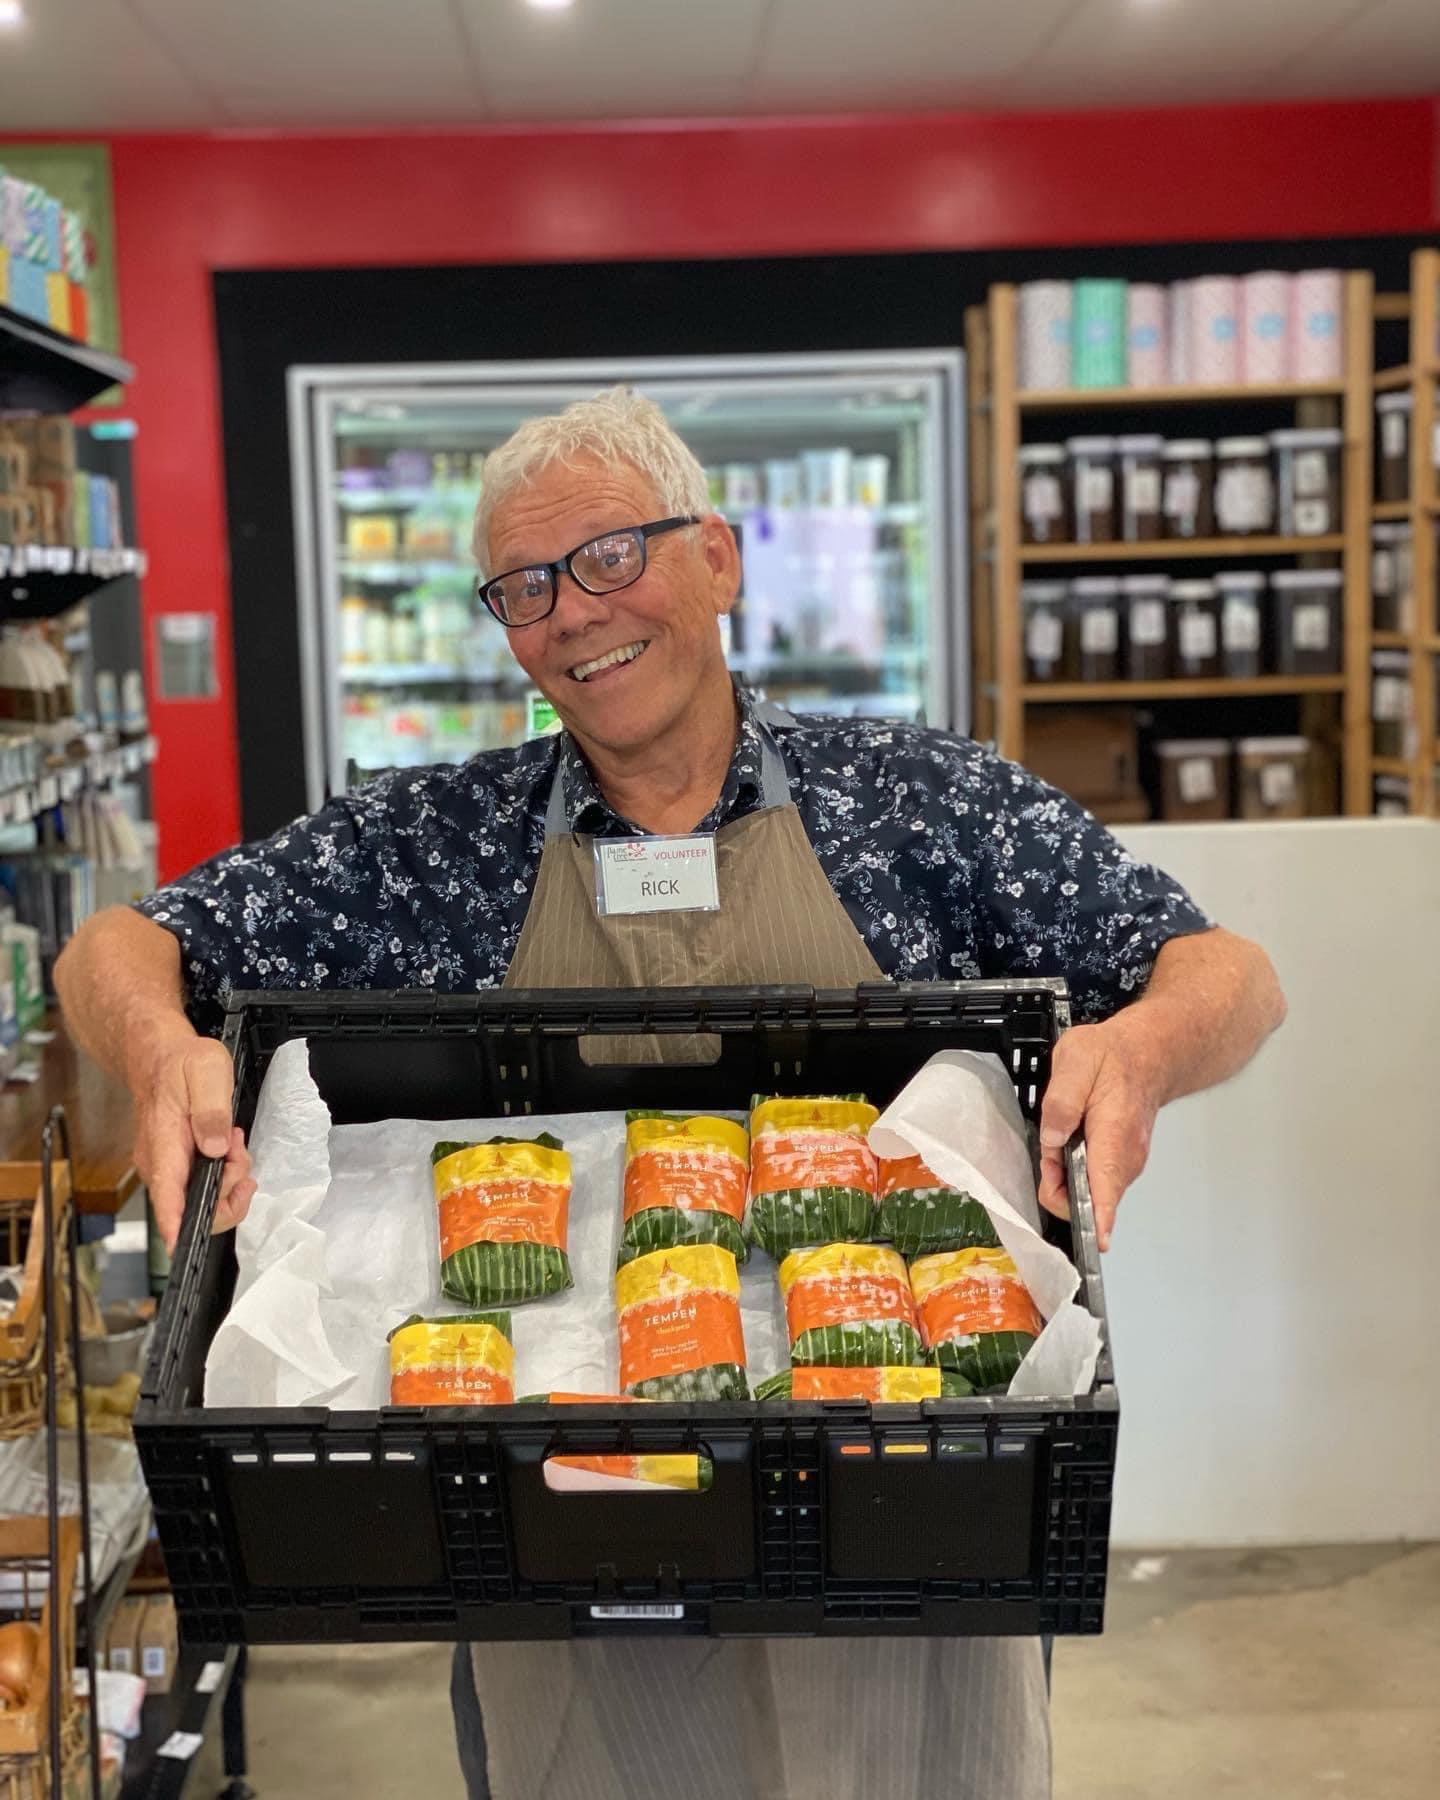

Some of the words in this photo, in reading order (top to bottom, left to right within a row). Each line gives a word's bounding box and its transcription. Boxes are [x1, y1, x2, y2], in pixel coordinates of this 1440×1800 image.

[654, 849, 708, 861] VOLUNTEER
[641, 879, 681, 897] RICK
[644, 1307, 697, 1328] TEMPEH
[436, 1381, 493, 1391] TEMPEH
